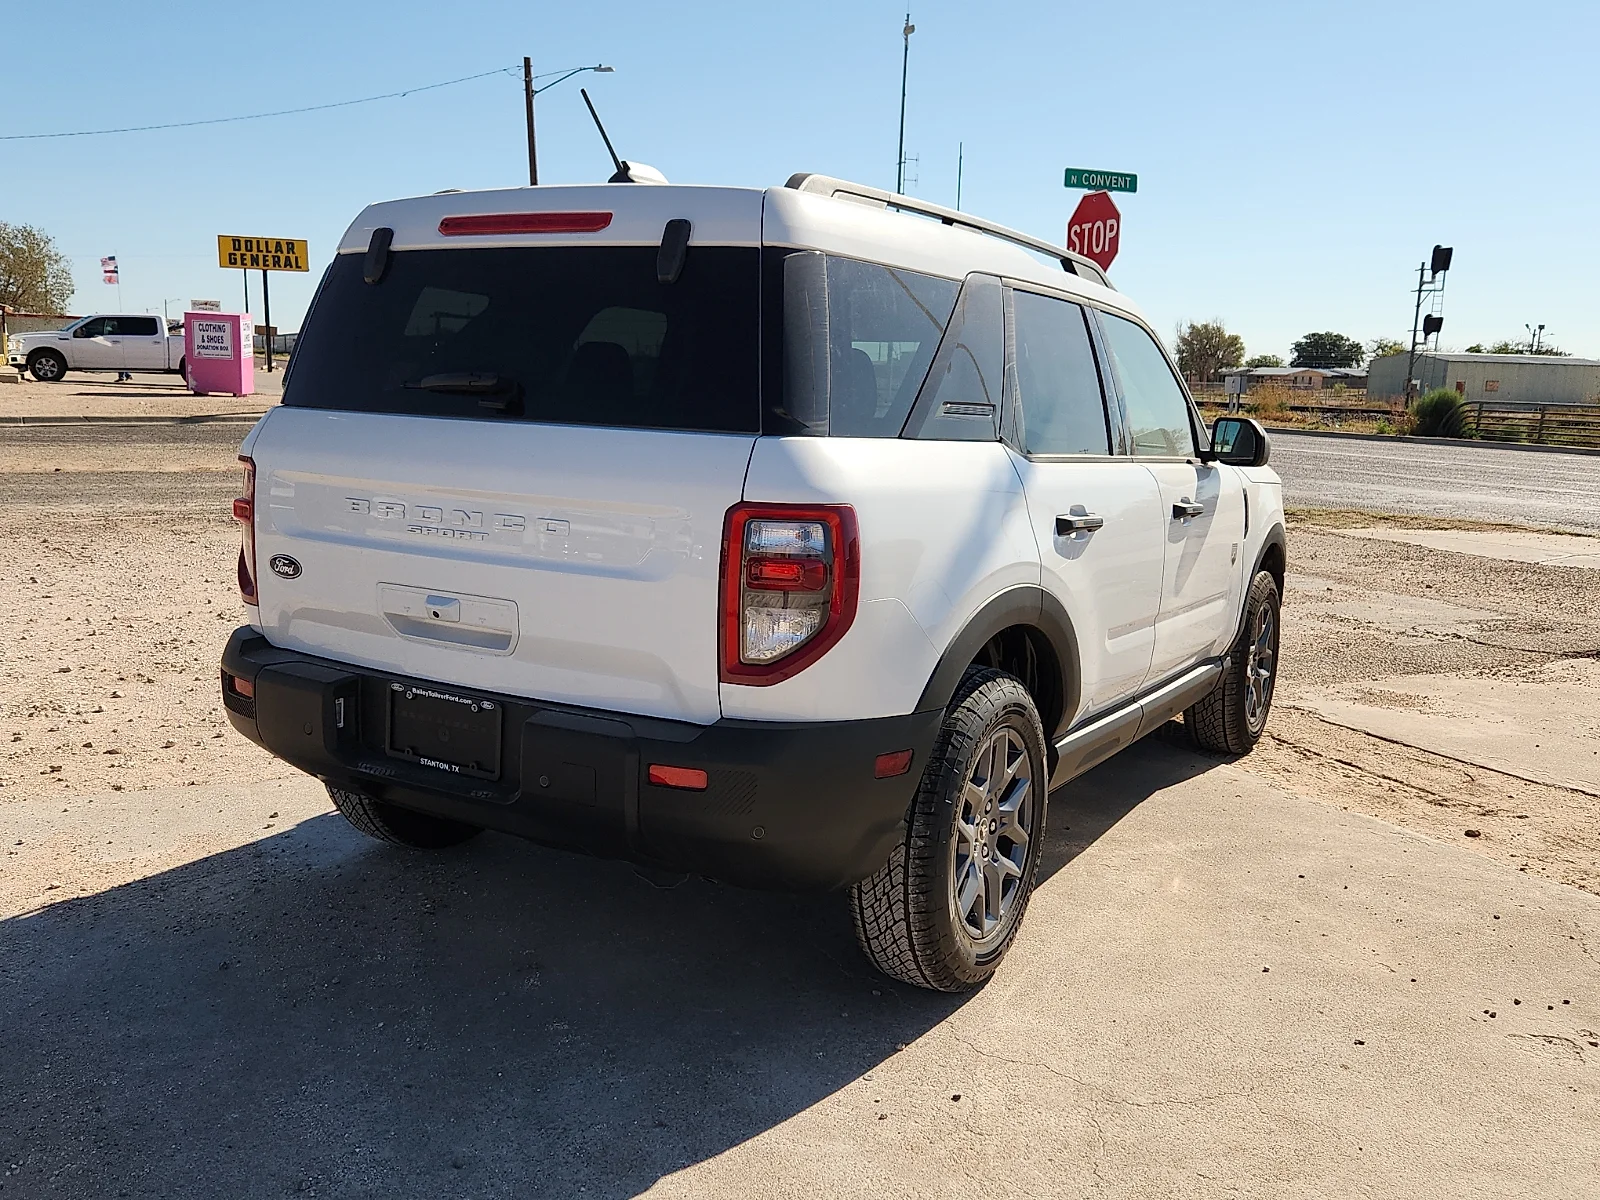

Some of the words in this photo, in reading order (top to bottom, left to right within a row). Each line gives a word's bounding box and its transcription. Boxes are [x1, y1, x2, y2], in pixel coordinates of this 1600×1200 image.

[1070, 175, 1078, 185] N
[1082, 173, 1131, 189] CONVENT
[1069, 219, 1118, 255] STOP
[231, 238, 296, 255] DOLLAR
[228, 252, 302, 269] GENERAL
[198, 323, 226, 333] CLOTHING
[201, 335, 205, 343] &
[206, 335, 225, 344] SHOES
[344, 497, 571, 537] BRONCO
[406, 524, 490, 541] SPORT
[420, 757, 451, 772] STANTON,
[451, 764, 460, 773] TX
